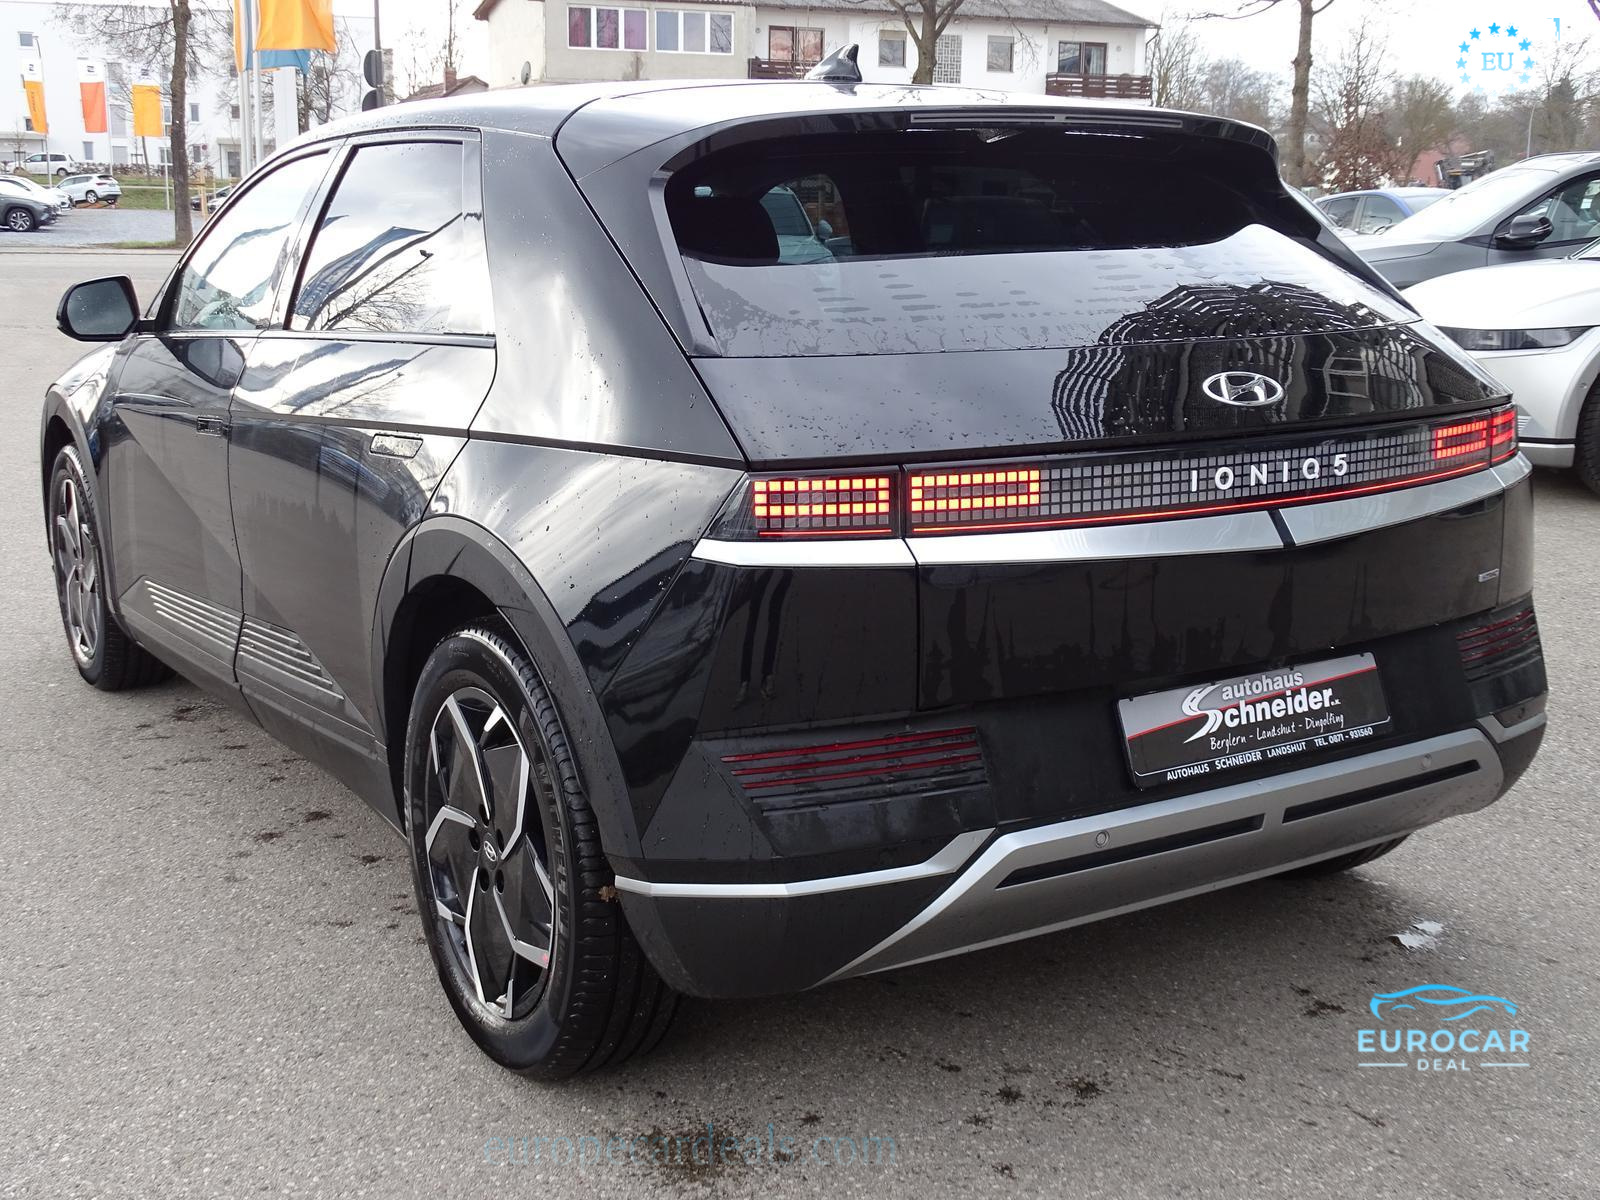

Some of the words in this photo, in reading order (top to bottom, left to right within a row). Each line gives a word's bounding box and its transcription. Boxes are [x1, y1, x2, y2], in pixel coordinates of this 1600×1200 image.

[1190, 457, 1321, 492] IONIQ
[1333, 453, 1348, 477] 5
[1221, 670, 1304, 701] autohaus
[1166, 763, 1210, 780] AUTOHAUS
[1215, 751, 1262, 770] SCHNEIDER
[1266, 741, 1307, 758] LANDSHUT
[1314, 737, 1328, 747] TEL.
[1328, 734, 1345, 745] 0871
[1349, 726, 1373, 740] 931560
[1209, 735, 1247, 754] Berglern
[1256, 721, 1295, 741] Landshut
[1304, 713, 1345, 732] Dingolfing
